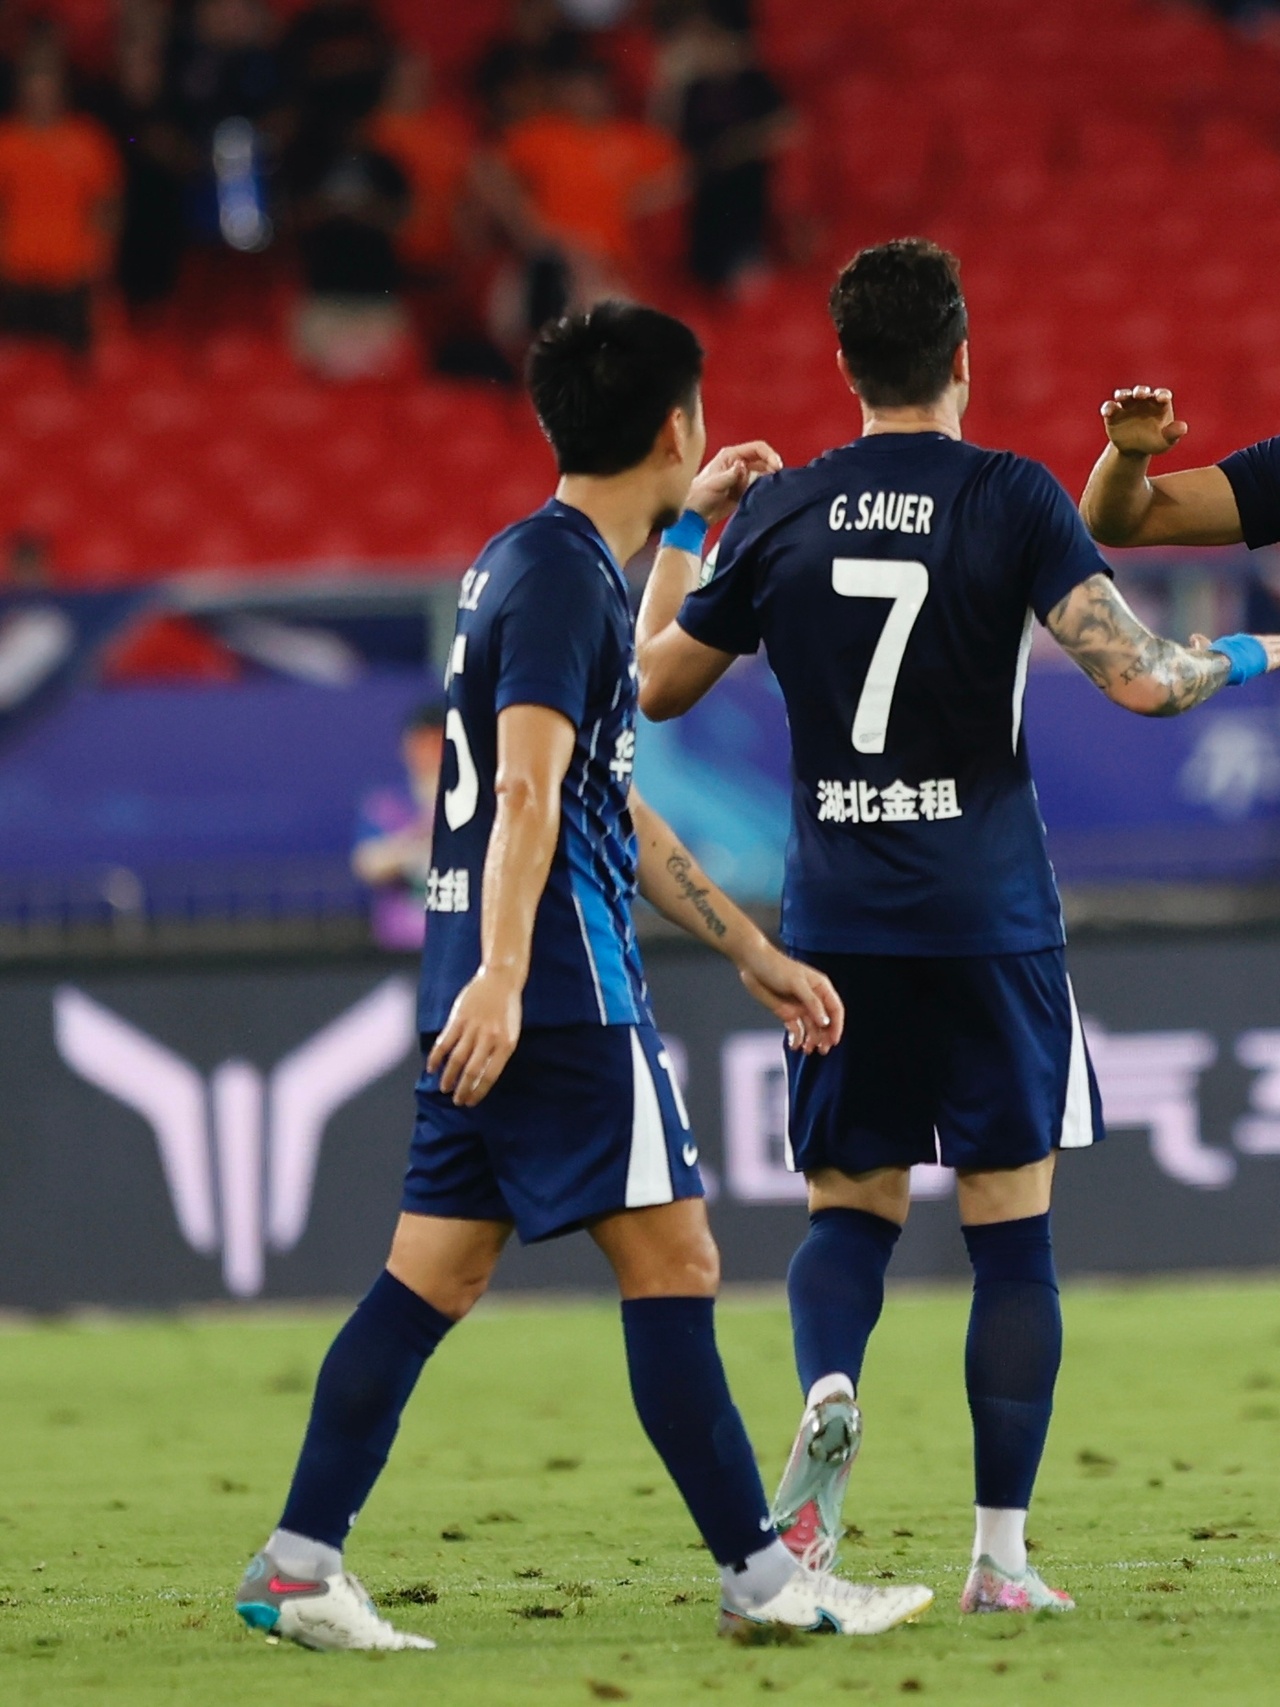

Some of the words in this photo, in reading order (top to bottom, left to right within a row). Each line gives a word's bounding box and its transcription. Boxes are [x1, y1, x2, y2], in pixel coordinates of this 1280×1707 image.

[829, 490, 934, 535] G.SAUER
[832, 557, 929, 753] 7
[816, 778, 962, 823] 湖北金租
